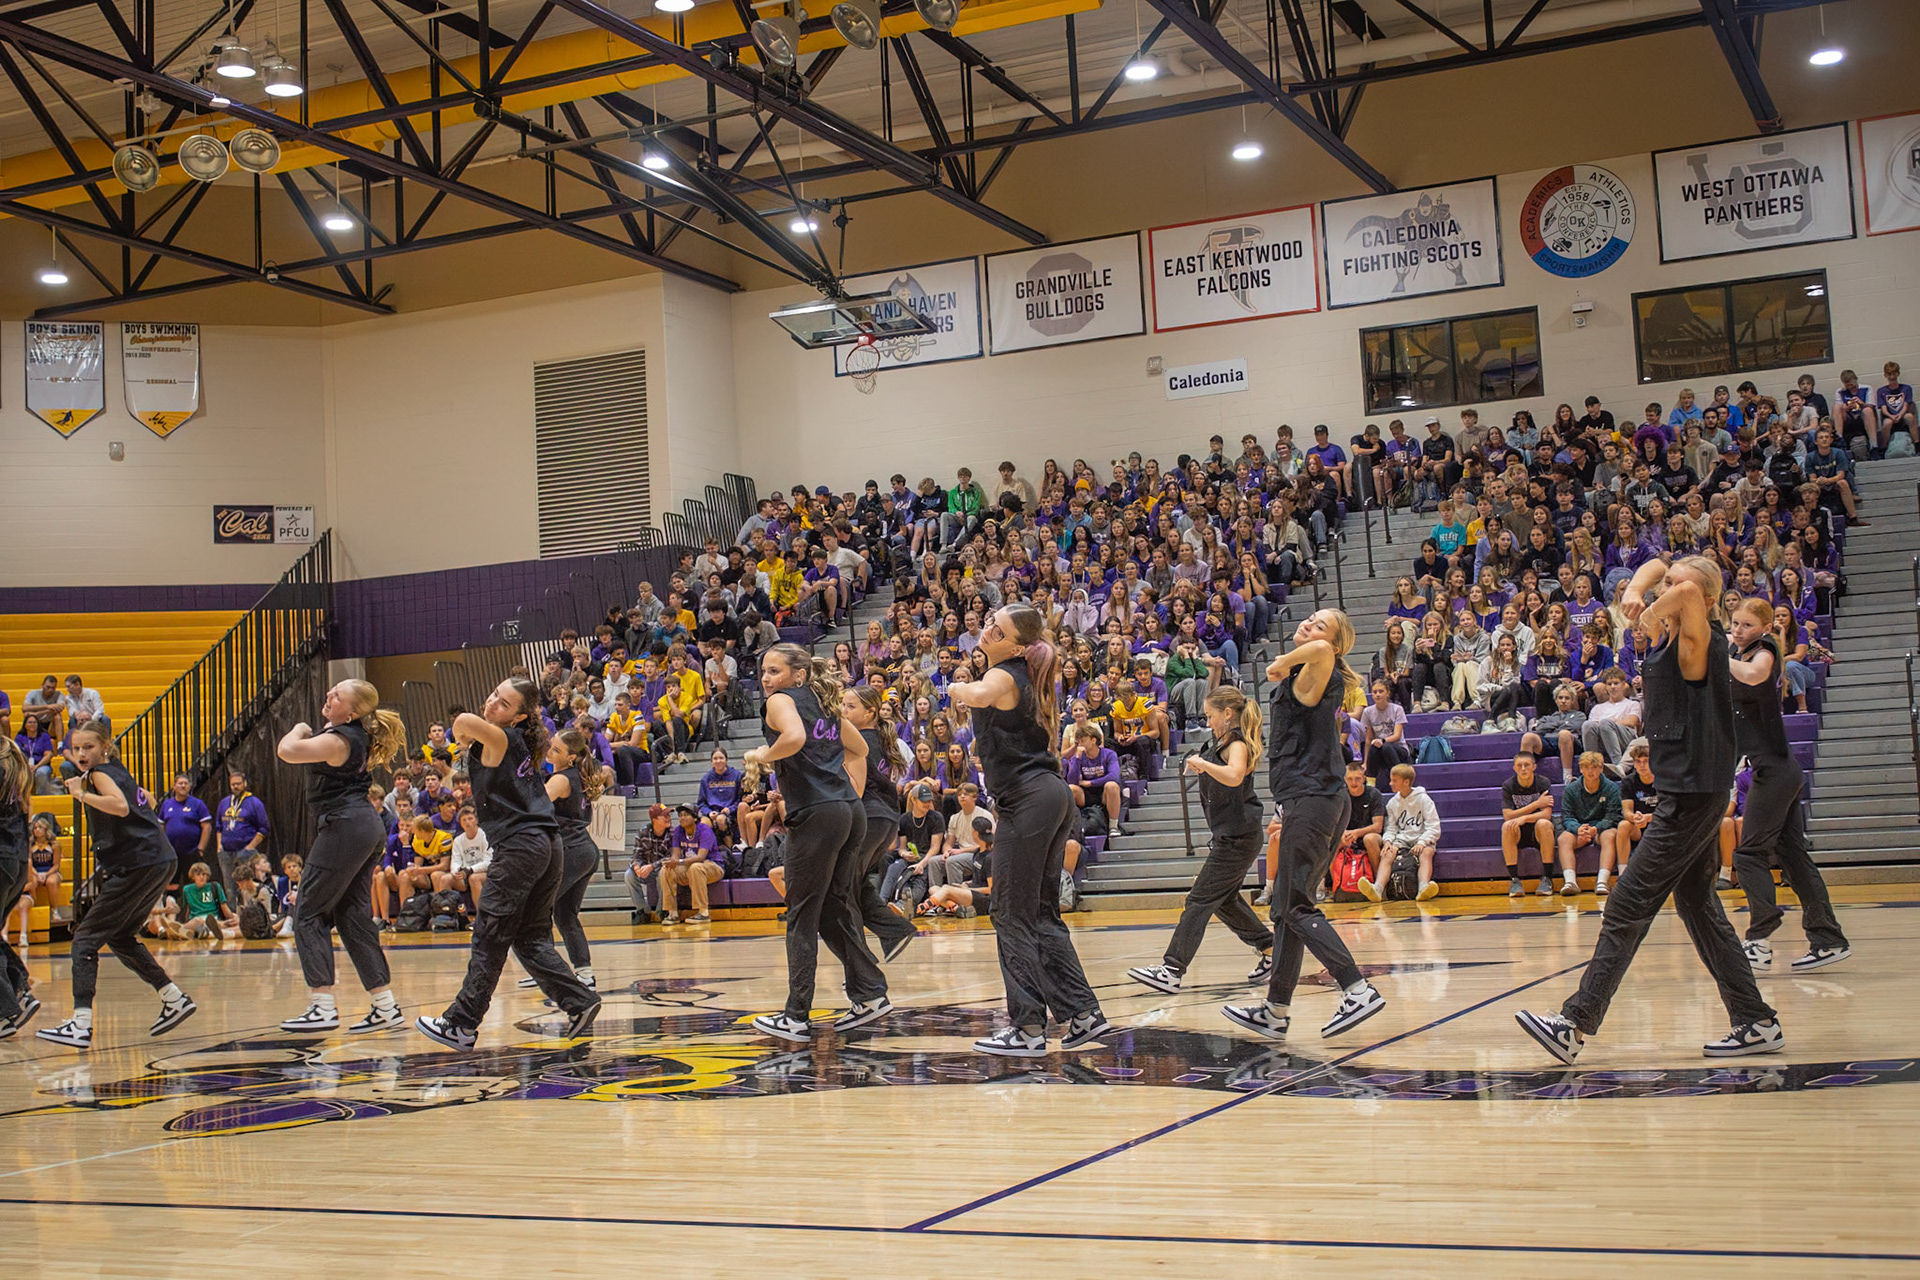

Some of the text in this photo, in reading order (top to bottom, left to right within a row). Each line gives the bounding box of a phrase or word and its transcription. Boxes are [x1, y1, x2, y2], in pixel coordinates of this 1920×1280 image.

[1681, 165, 1824, 202] WEST OTTAWA
[1526, 176, 1563, 240] ACADEMICS
[1562, 192, 1590, 204] 1958
[1569, 203, 1584, 212] THE
[1589, 172, 1631, 225] ATHLETICS
[1704, 194, 1804, 225] PANTHERS
[1362, 219, 1459, 249] CALEDONIA
[1569, 216, 1586, 228] OK
[1164, 240, 1303, 277] EAST KENTWOOD
[1343, 240, 1482, 276] FIGHTING SCOTS
[1015, 268, 1112, 299] GRANDVILLE
[1197, 269, 1271, 297] FALCONS
[1026, 293, 1104, 320] BULLDOGS
[28, 323, 100, 334] BOYS SKIING
[125, 324, 197, 335] BOYS SWIMMING
[1169, 368, 1244, 391] Caledonia
[219, 509, 268, 537] Cal
[279, 527, 309, 537] PFCU
[813, 718, 844, 741] Cal
[1396, 809, 1423, 831] Cal
